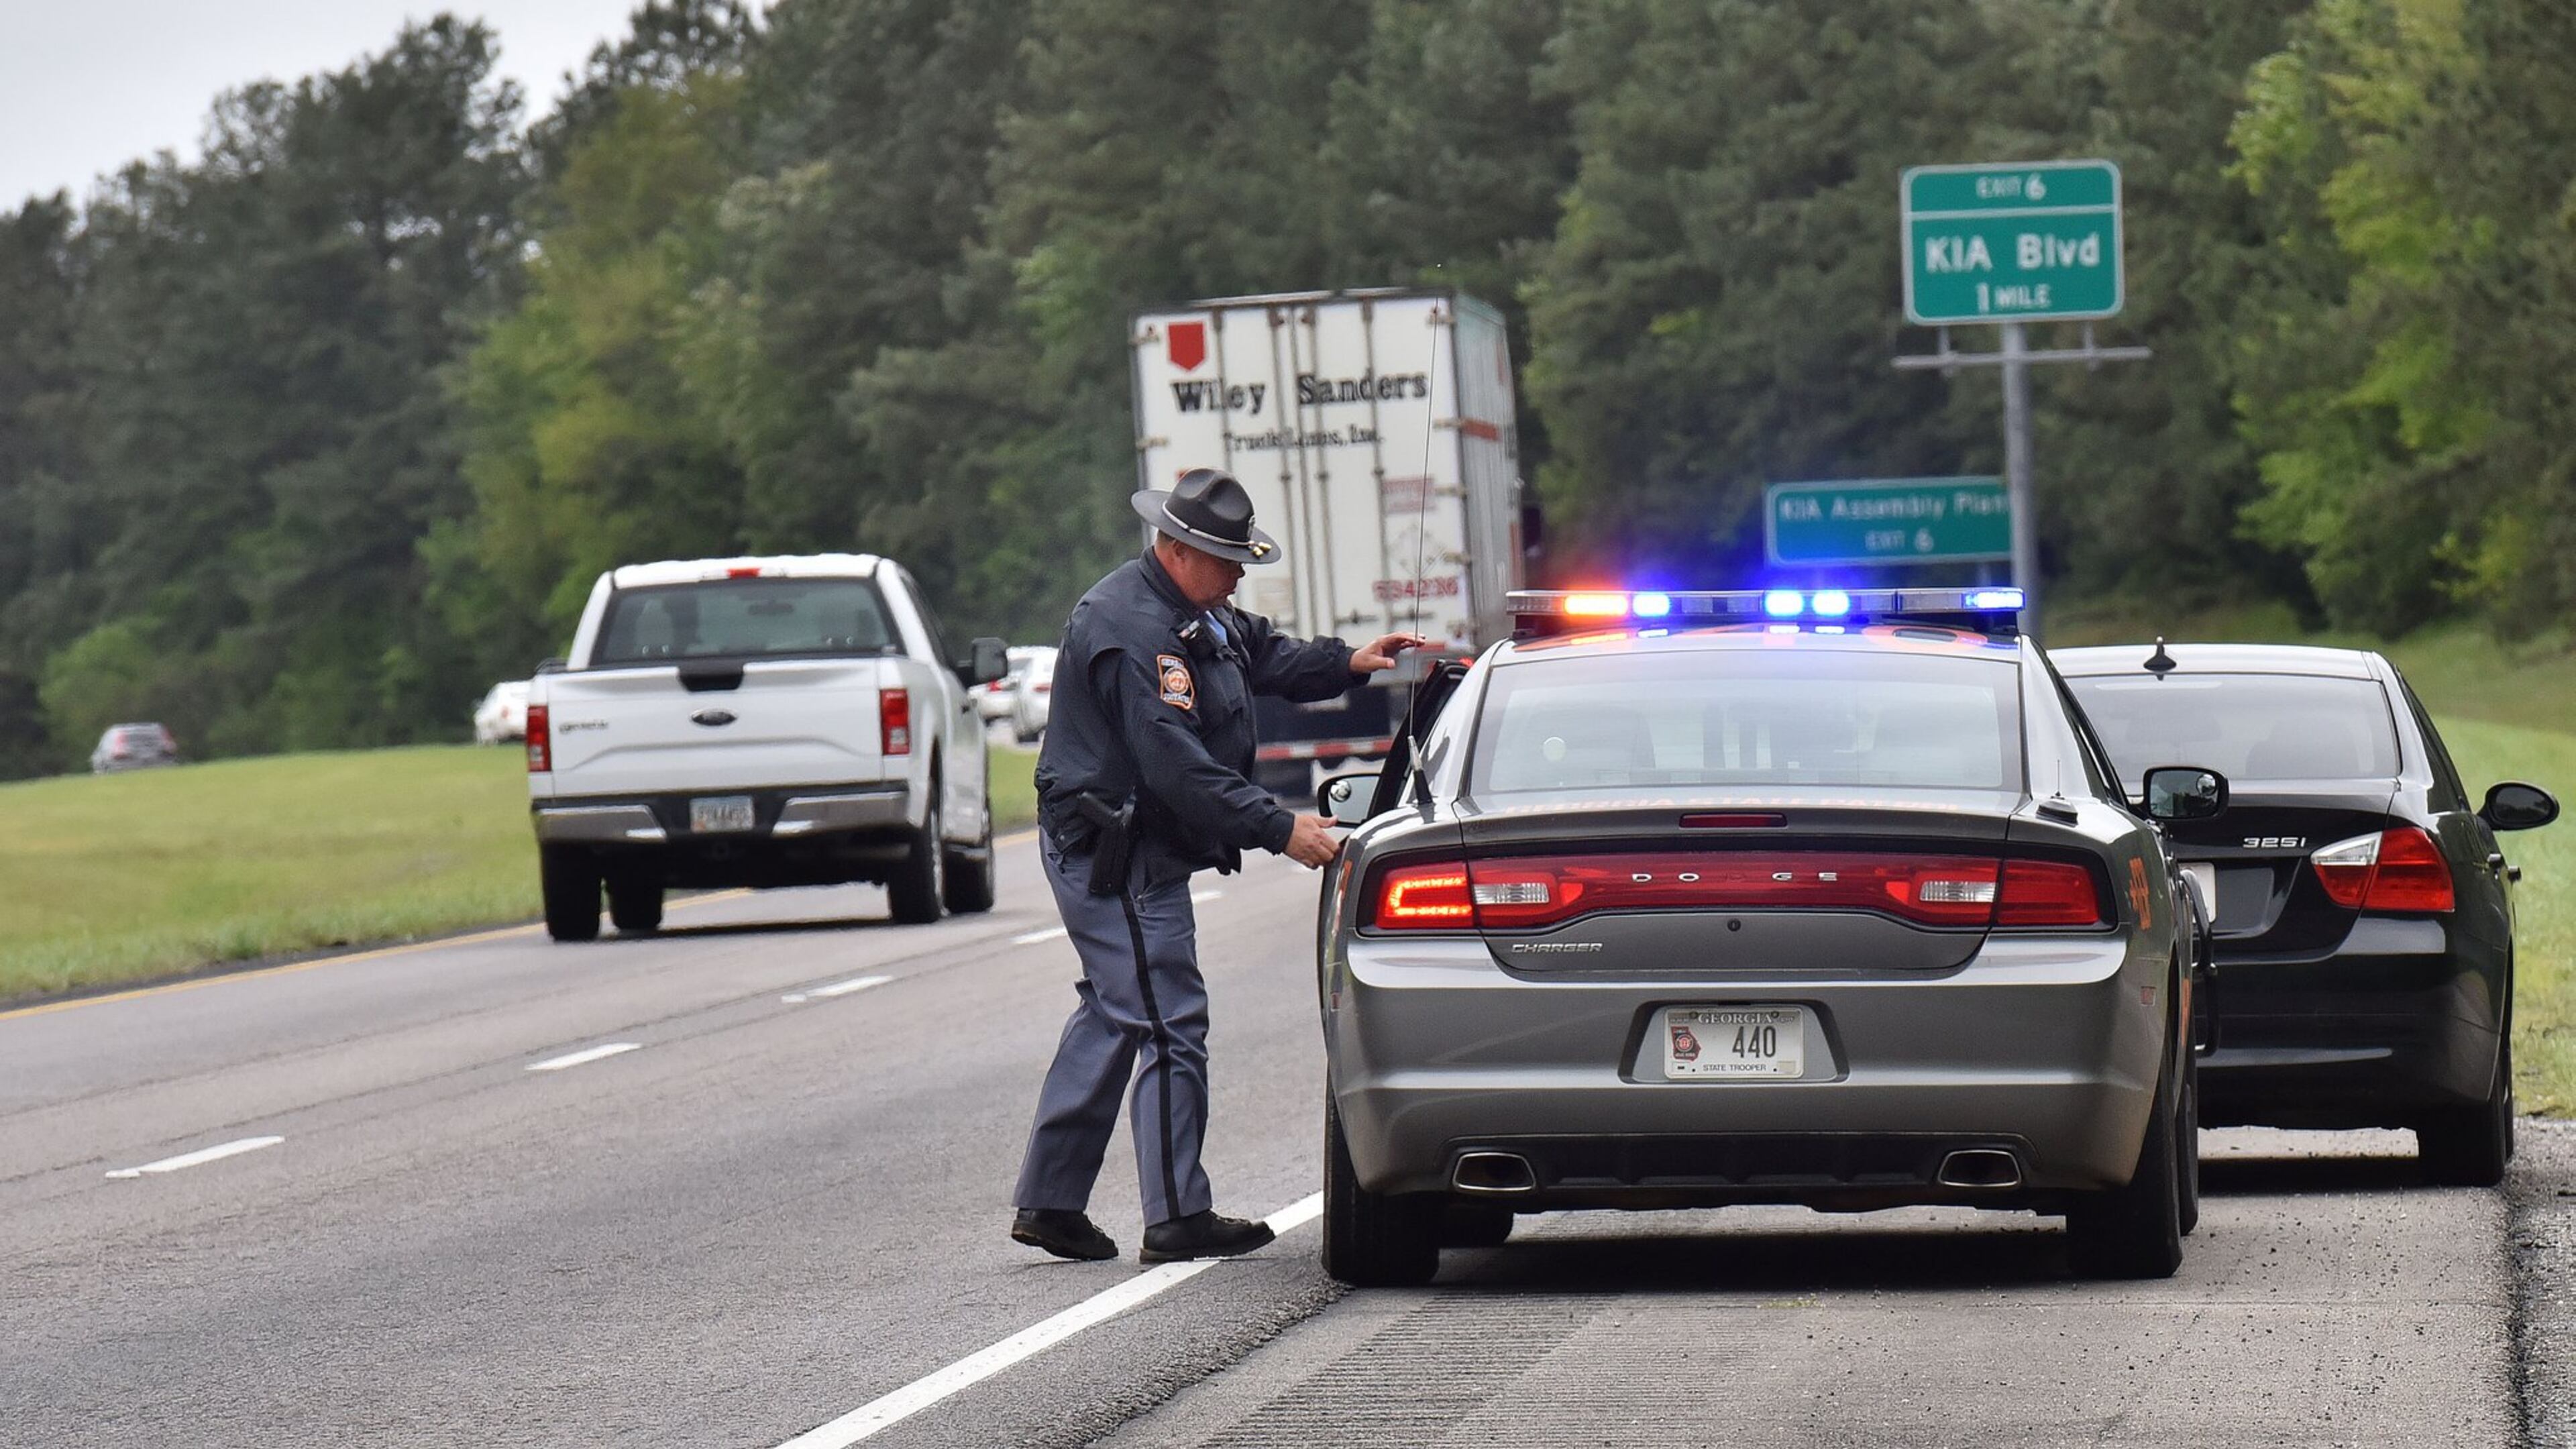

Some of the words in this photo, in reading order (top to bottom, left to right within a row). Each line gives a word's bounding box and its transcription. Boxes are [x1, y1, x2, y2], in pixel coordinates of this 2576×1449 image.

[2025, 173, 2047, 200] 6
[1925, 235, 1993, 273] KIA
[2017, 232, 2100, 269] Blvd
[1976, 282, 1990, 312] 1
[1994, 284, 2052, 309] MILE
[1170, 379, 1267, 414] Wiley
[1297, 370, 1428, 405] Sanders
[1779, 495, 1823, 520] KIA
[1830, 494, 1947, 522] Assembly
[1914, 527, 1934, 553] 6
[1632, 871, 1837, 883] DOGE
[1511, 942, 1603, 953] CHARGER
[1698, 1012, 1773, 1024] GEORGIA
[1732, 1026, 1776, 1059] 440
[1703, 1063, 1726, 1072] STATE
[1729, 1063, 1767, 1072] TROOPER
